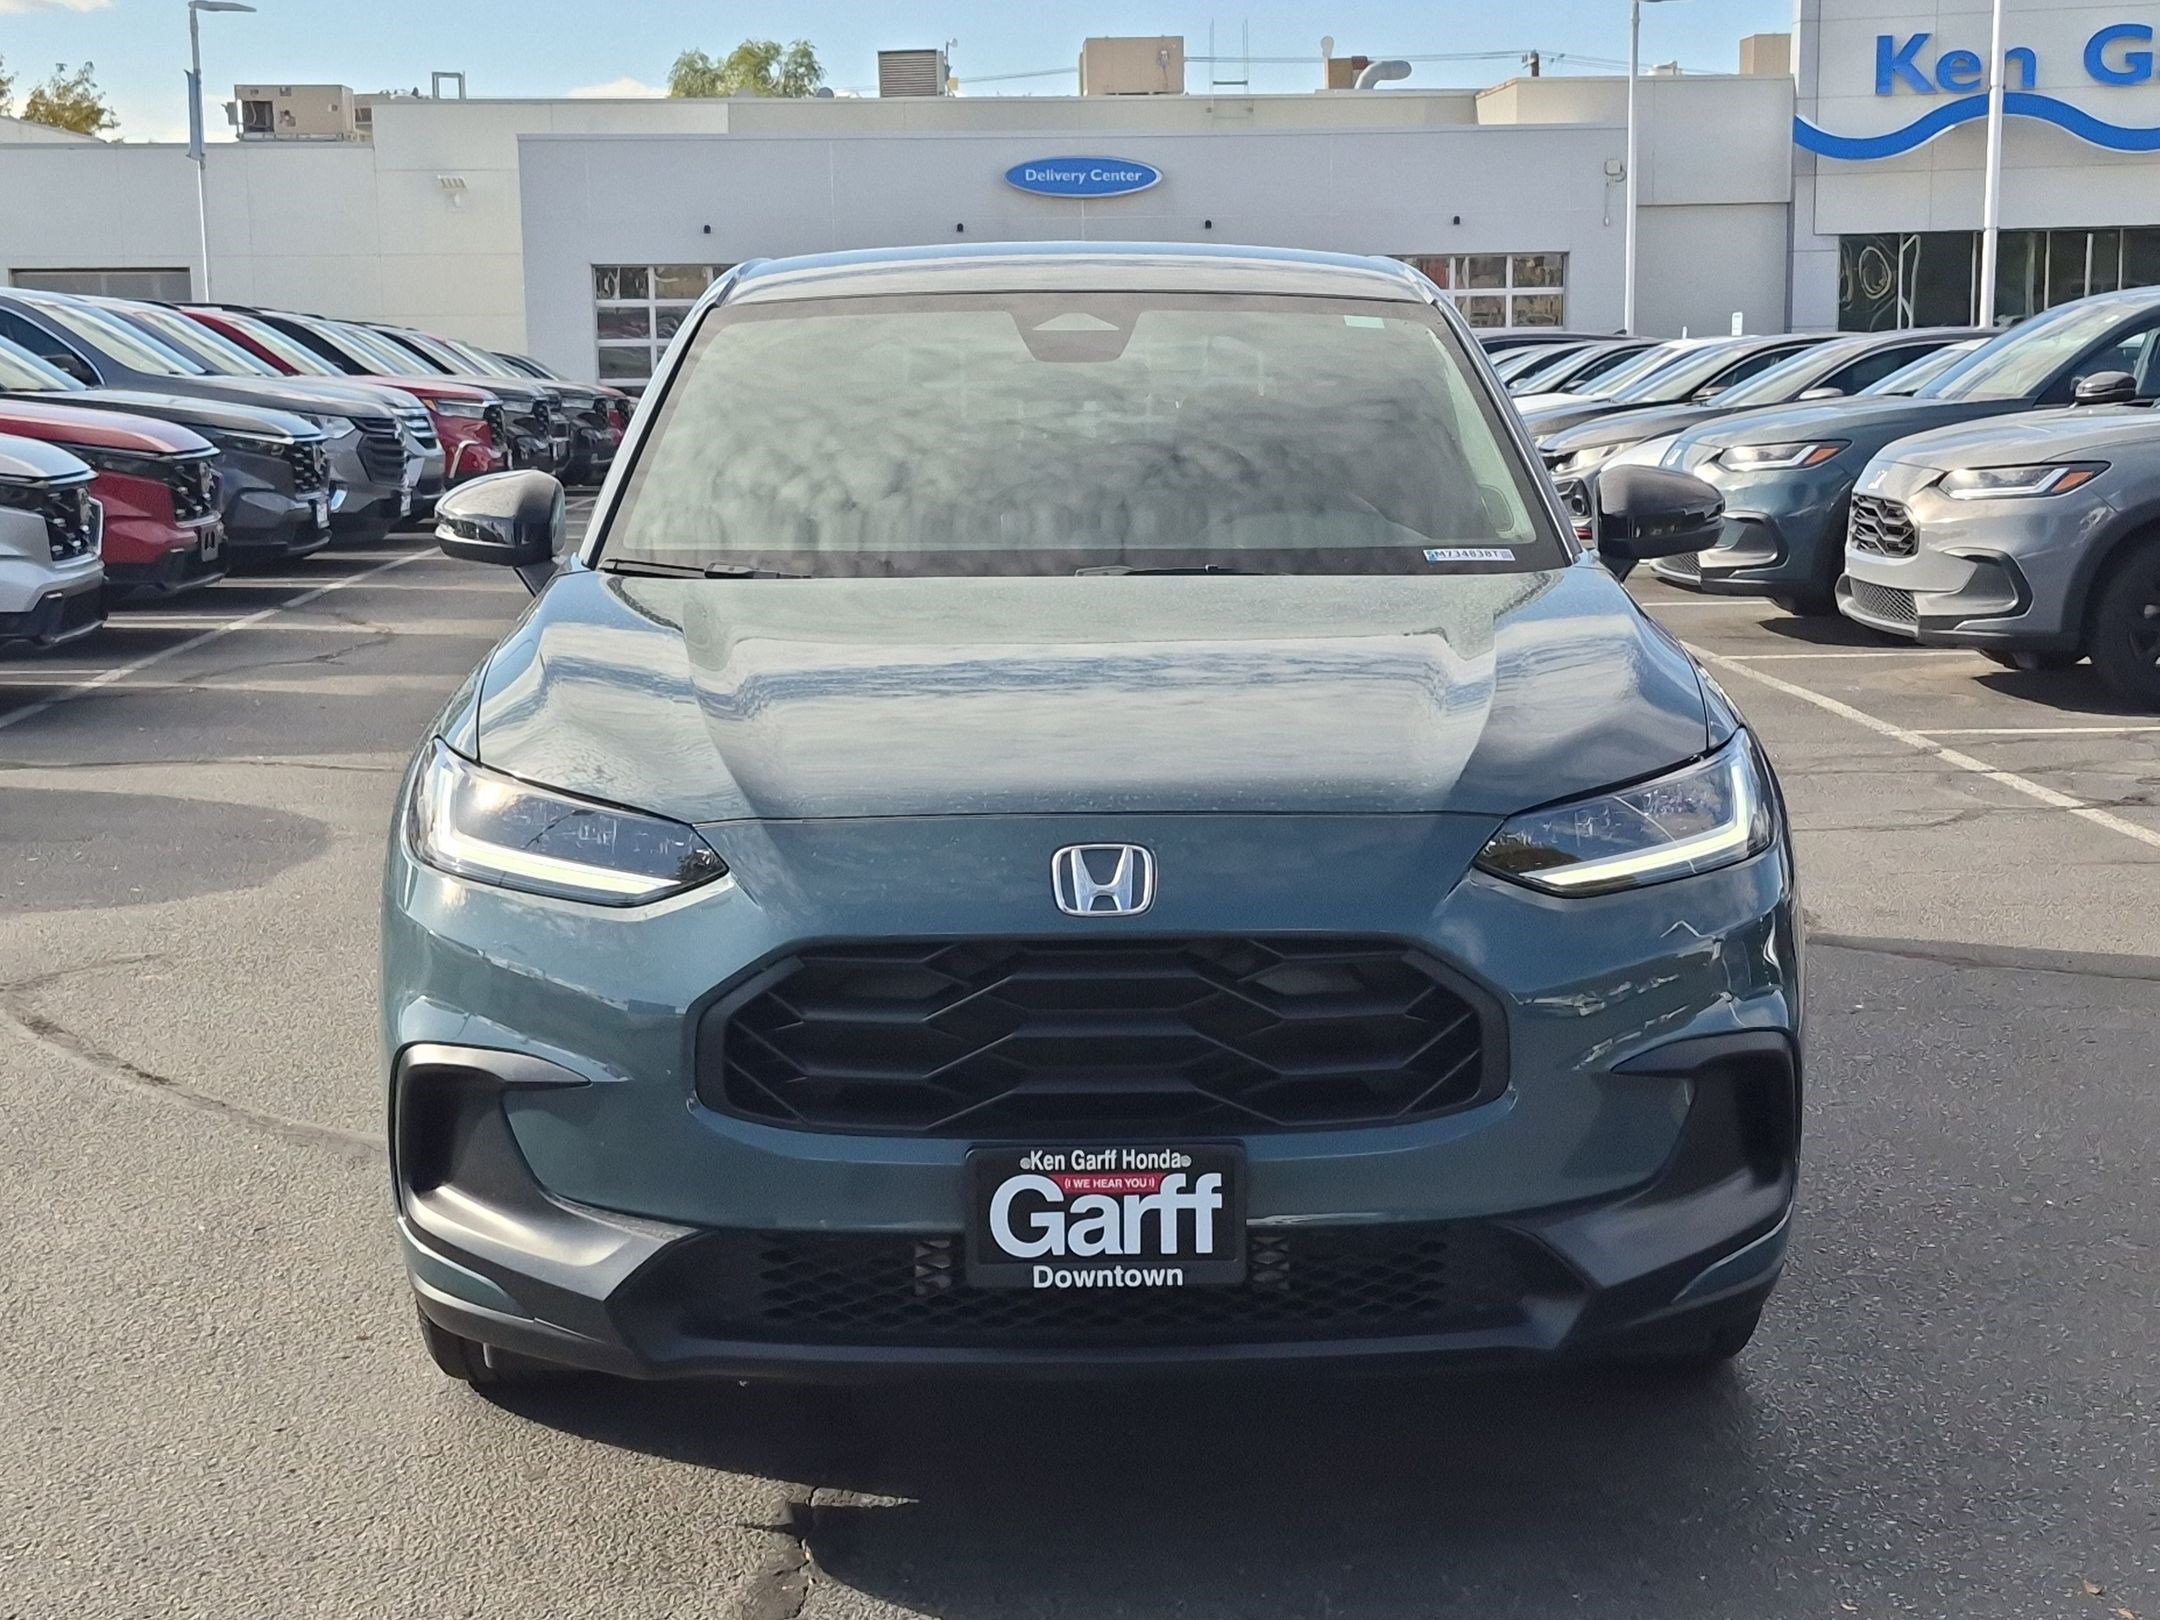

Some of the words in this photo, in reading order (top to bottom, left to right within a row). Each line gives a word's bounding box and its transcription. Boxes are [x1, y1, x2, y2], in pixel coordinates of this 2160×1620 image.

[1874, 33, 2037, 96] Ken
[2083, 23, 2160, 86] G
[1025, 169, 1086, 184] Delivery
[1090, 169, 1142, 182] Center
[1030, 1150, 1066, 1171] Ken
[1070, 1150, 1118, 1171] Garff
[1122, 1149, 1181, 1169] Honda
[1073, 1178, 1090, 1189] WE
[1093, 1178, 1122, 1189] HEAR
[1124, 1177, 1147, 1189] YOU
[989, 1173, 1223, 1259] Garff
[1032, 1265, 1184, 1289] Downtown
